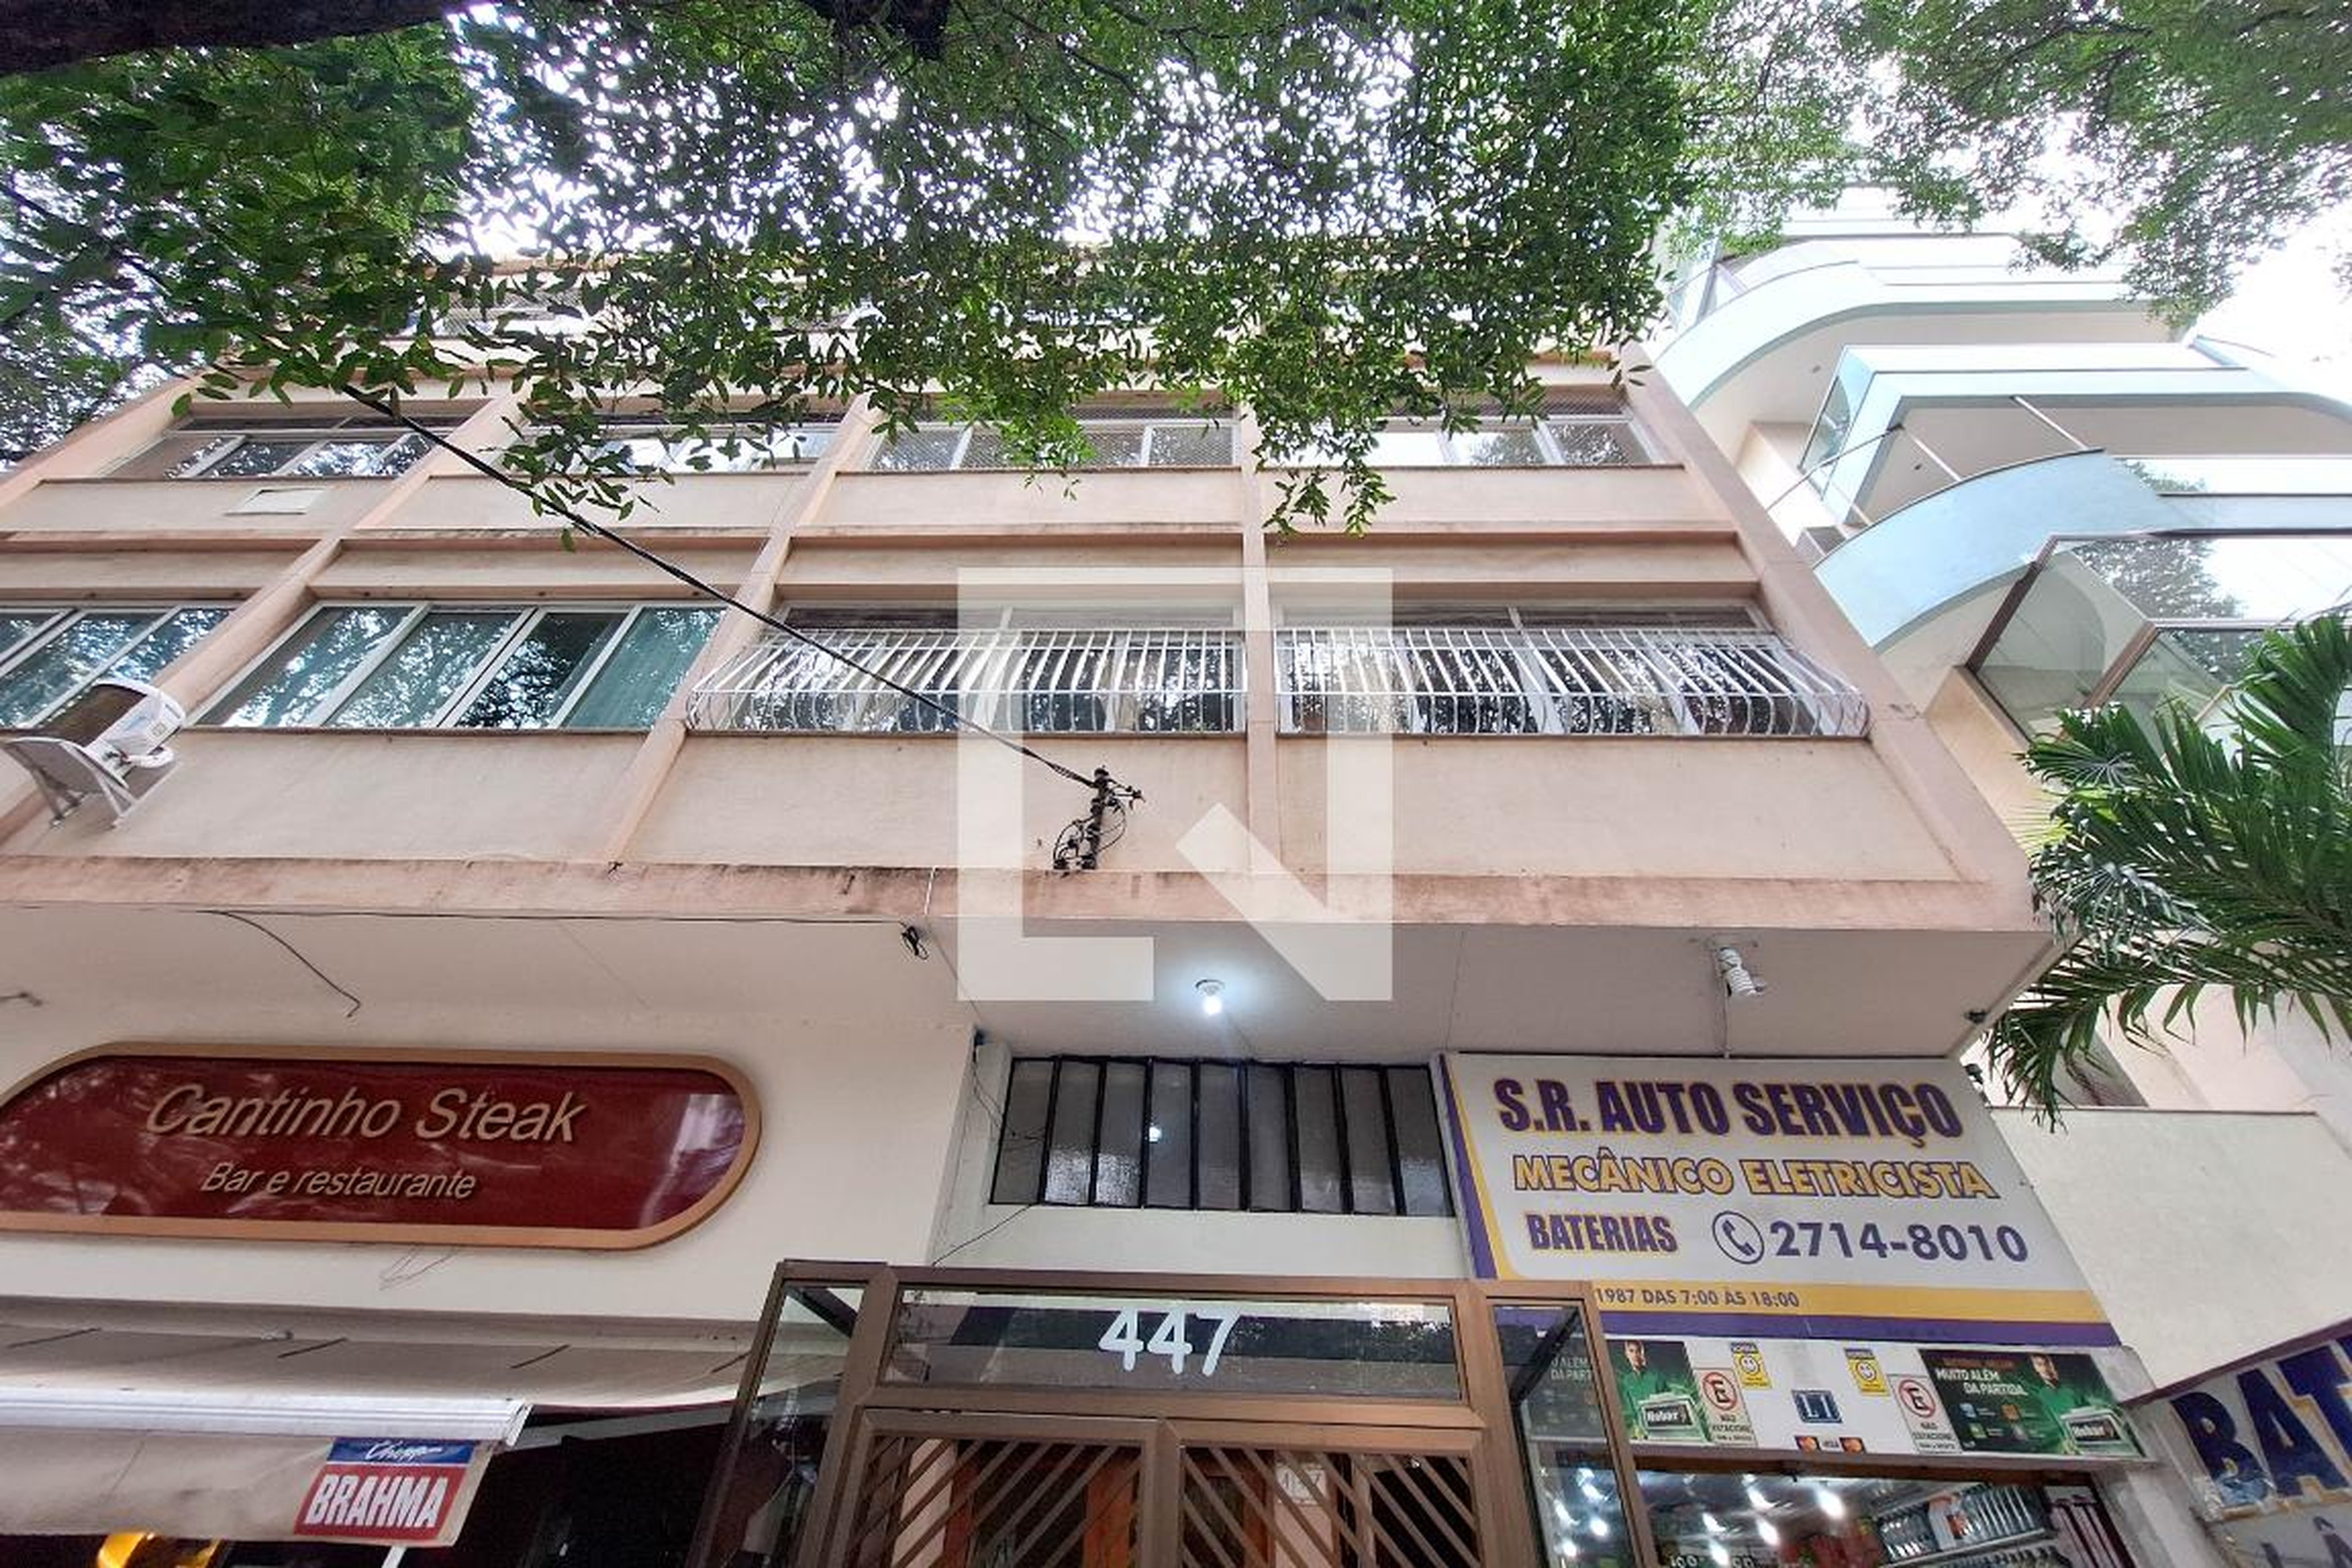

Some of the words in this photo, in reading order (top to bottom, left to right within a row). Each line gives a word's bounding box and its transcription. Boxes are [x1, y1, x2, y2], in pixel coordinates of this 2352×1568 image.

[146, 1084, 401, 1138] Cantinho
[416, 1087, 587, 1143] Steak
[1494, 1079, 1592, 1132] S.R.
[1596, 1081, 1730, 1136] AUTO
[1733, 1083, 1964, 1148] SERVIÇO
[200, 1161, 265, 1193] Bar
[266, 1170, 290, 1194] e
[294, 1168, 478, 1199] restaurante
[1513, 1146, 1735, 1195] MECÂNICO
[1738, 1159, 2001, 1199] ELETRICISTA
[1525, 1213, 1679, 1253] BATERIAS
[1770, 1221, 2029, 1262] 2714-8010
[1596, 1288, 1635, 1303] 1987
[1642, 1289, 1677, 1305] DAS
[1683, 1289, 1719, 1306] 7:00
[1751, 1291, 1800, 1308] 18:00
[1098, 1305, 1240, 1377] 447
[2169, 1335, 2352, 1508] BAT
[303, 1474, 448, 1528] BRAHMA
